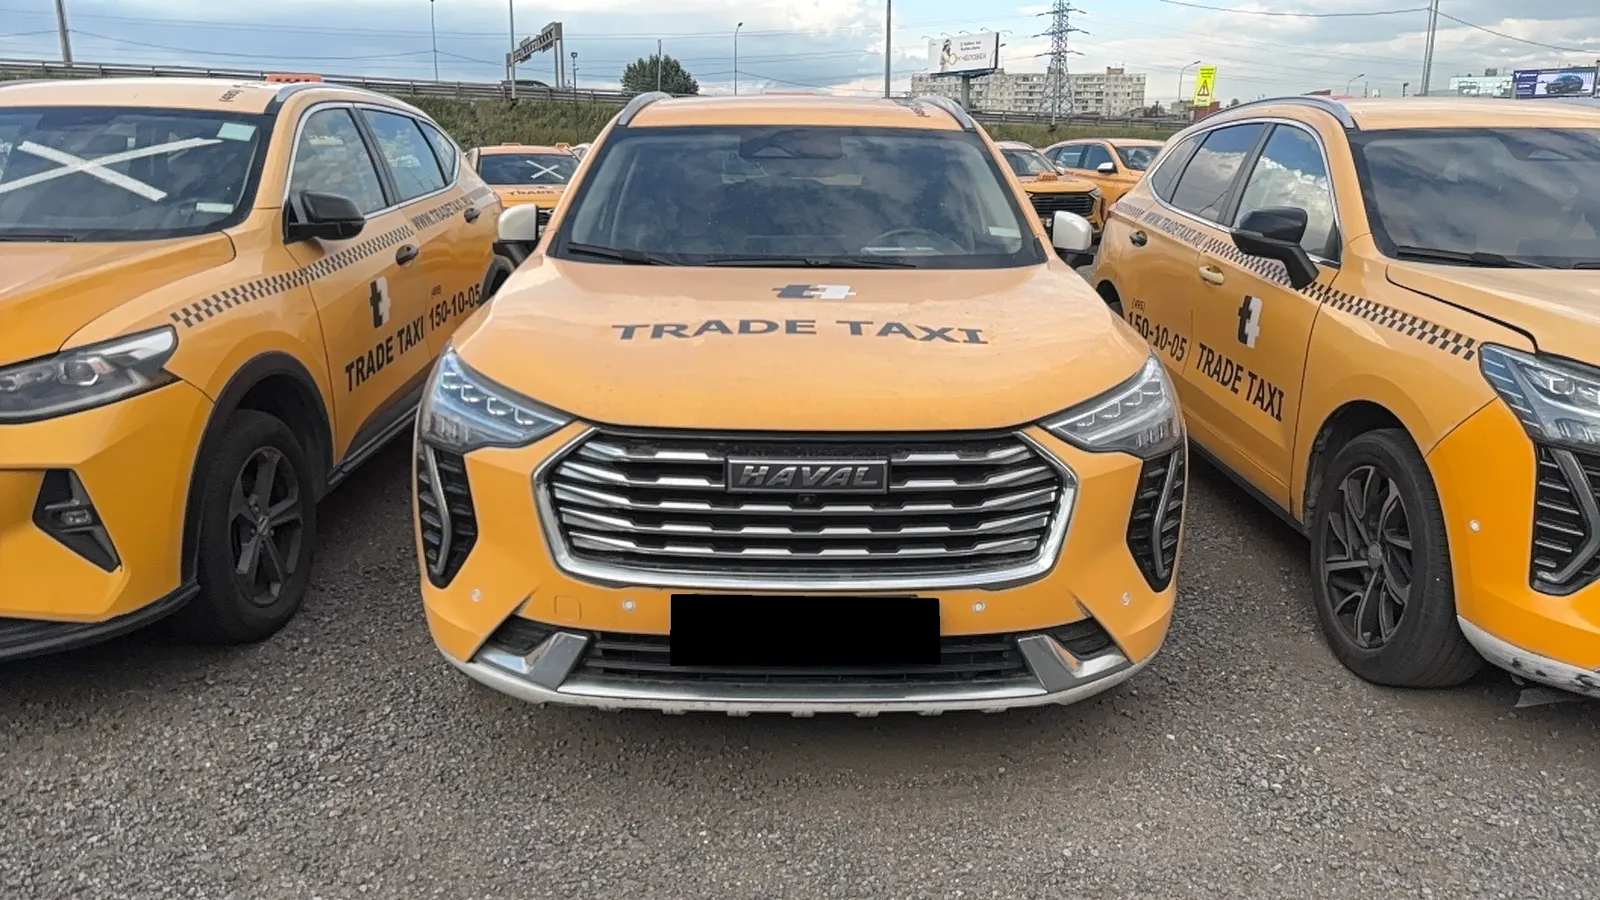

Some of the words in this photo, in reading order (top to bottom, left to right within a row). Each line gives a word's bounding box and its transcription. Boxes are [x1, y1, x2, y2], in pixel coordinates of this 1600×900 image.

[429, 282, 481, 331] 150-10-05
[1132, 297, 1146, 313] (495)
[345, 335, 394, 392] TRADE
[397, 315, 425, 355] TAXI
[612, 319, 817, 340] TRADE
[836, 320, 989, 345] TAXI
[1128, 311, 1188, 362] 150-10-05
[1196, 342, 1244, 395] TRADE
[1246, 371, 1285, 422] TAXI
[738, 465, 878, 487] HAVAL
